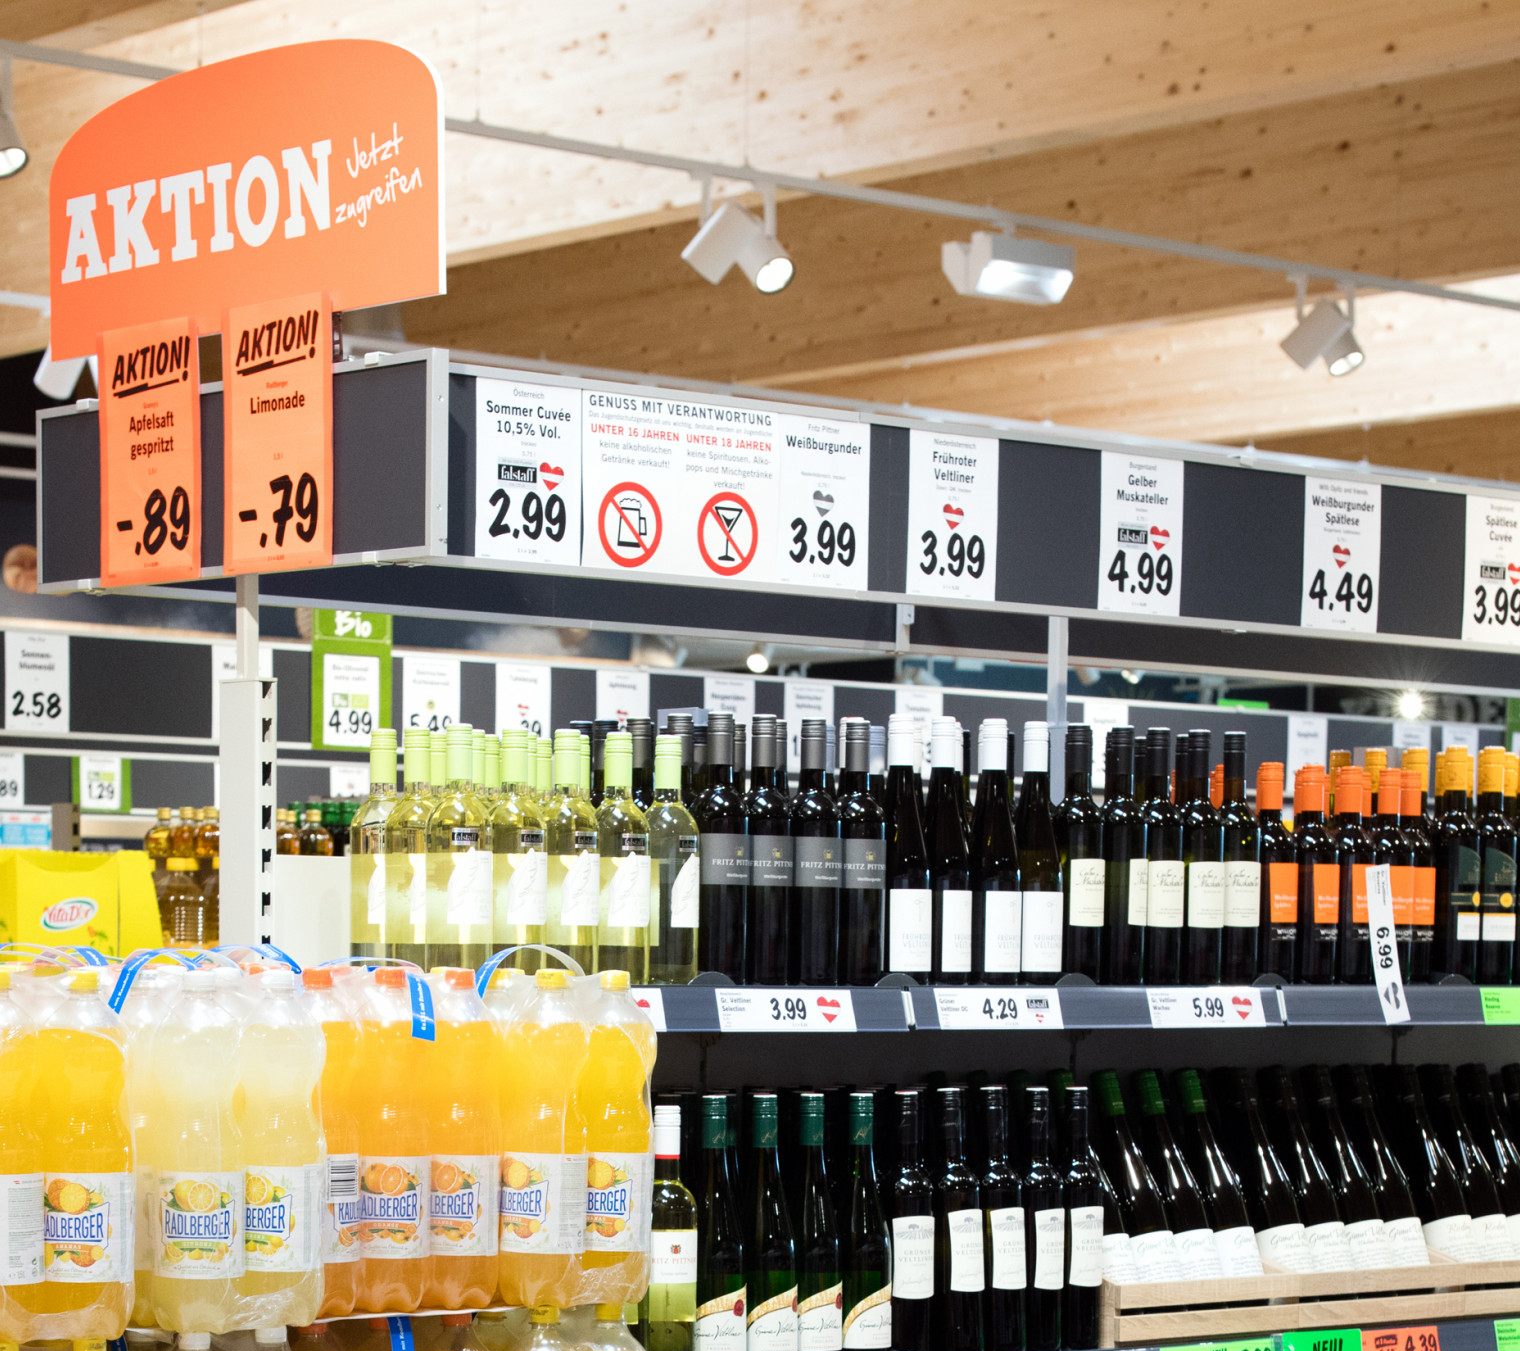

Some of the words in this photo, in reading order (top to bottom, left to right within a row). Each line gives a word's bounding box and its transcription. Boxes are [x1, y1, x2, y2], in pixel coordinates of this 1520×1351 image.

[346, 122, 404, 178] Jetzt
[335, 167, 423, 228] zugreifen
[61, 139, 332, 284] AKTION
[236, 310, 319, 367] AKTION!
[112, 336, 190, 389] AKTION!
[250, 391, 305, 415] Limonade
[486, 400, 533, 418] Sommer
[537, 406, 571, 422] Cuvée
[589, 394, 637, 411] GENUSS
[642, 400, 663, 415] MIT
[668, 403, 772, 426] VERANTWORTUNG
[129, 411, 174, 435] Apfelsaft
[497, 420, 536, 437] 10,5%
[539, 425, 561, 439] Vol.
[591, 423, 624, 436] UNTER
[628, 428, 639, 437] 16
[642, 429, 680, 442] JAHREN
[130, 436, 174, 460] gespritzt
[600, 440, 620, 450] keine
[622, 442, 672, 455] alkoholischen
[686, 433, 718, 446] UNTER
[722, 437, 732, 447] 18
[736, 439, 772, 452] JAHREN
[687, 449, 706, 460] keine
[786, 434, 862, 455] Weißburgunder
[601, 453, 635, 465] Getränke
[638, 458, 670, 470] verkauft!
[932, 450, 977, 468] Frühroter
[500, 465, 536, 483] falstaff
[685, 463, 703, 474] pops
[705, 464, 719, 474] und
[721, 465, 773, 481] Mischgetränke
[934, 467, 974, 484] Veltliner
[1128, 474, 1157, 488] Gelber
[713, 479, 745, 491] verkauft!
[1116, 489, 1169, 506] Muskateller
[1312, 495, 1375, 512] Weißburgunder
[117, 486, 190, 556] -.89
[239, 472, 319, 548] -.79
[488, 488, 566, 543] 2.99
[1325, 512, 1360, 527] Spätlese
[789, 517, 856, 567] 3.99
[919, 530, 985, 579] 3.99
[1107, 549, 1173, 596] 4.99
[1309, 569, 1373, 613] 4.49
[1473, 585, 1520, 626] 3.99
[334, 610, 372, 638] Bio
[12, 690, 62, 719] 2.58
[328, 709, 372, 735] 4.99
[712, 858, 734, 866] FRITZ
[800, 861, 822, 869] FRITZ
[1376, 926, 1394, 969] 6.99
[769, 997, 807, 1021] 3.99
[982, 997, 1018, 1020] 4.29
[1192, 997, 1225, 1018] 5.99
[165, 1210, 231, 1239] RADLBERGER
